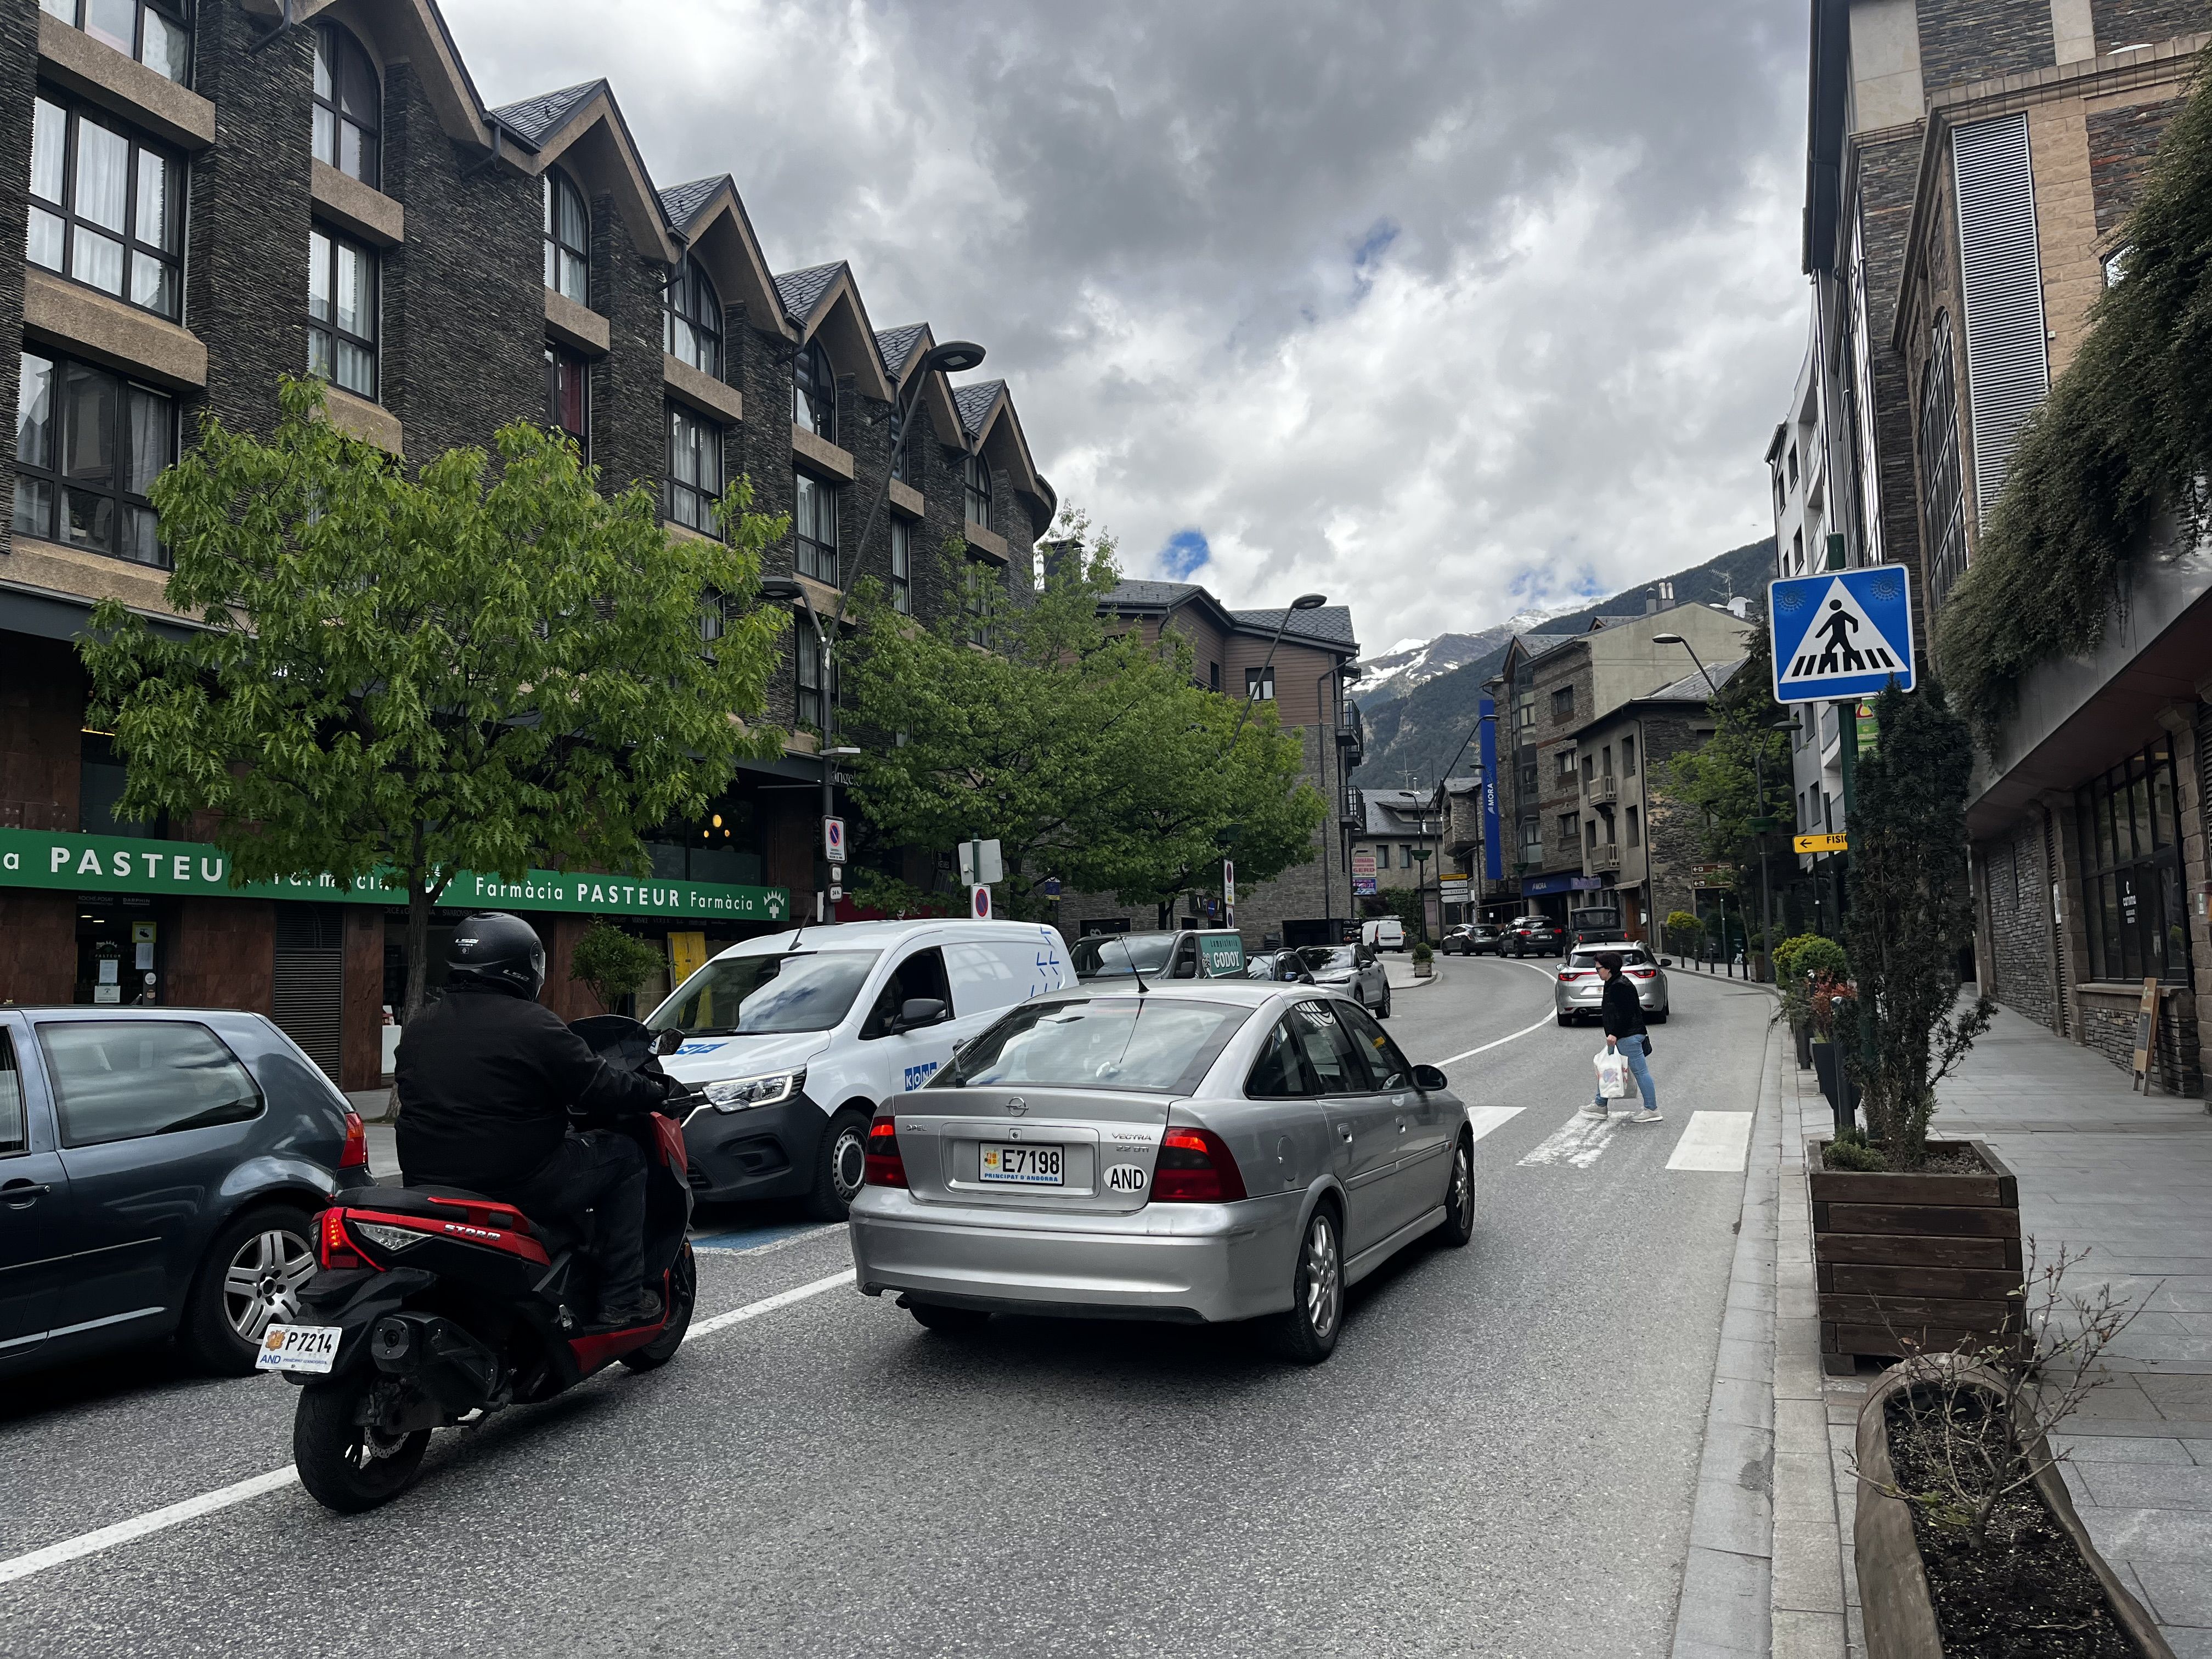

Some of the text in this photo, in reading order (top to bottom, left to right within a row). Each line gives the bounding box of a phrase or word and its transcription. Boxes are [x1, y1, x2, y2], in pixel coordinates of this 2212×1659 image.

[50, 847, 251, 884] PASTEU
[476, 877, 753, 910] Farmàcia PASTEUR Farmàcia
[1214, 951, 1240, 968] GODOY
[906, 1069, 936, 1088] KON
[1112, 1132, 1152, 1141] VECTRA
[1002, 1149, 1059, 1175] E7198
[1110, 1168, 1144, 1189] AND
[444, 1224, 501, 1241] STORM
[285, 1331, 332, 1353] P7214
[259, 1355, 281, 1364] AND
